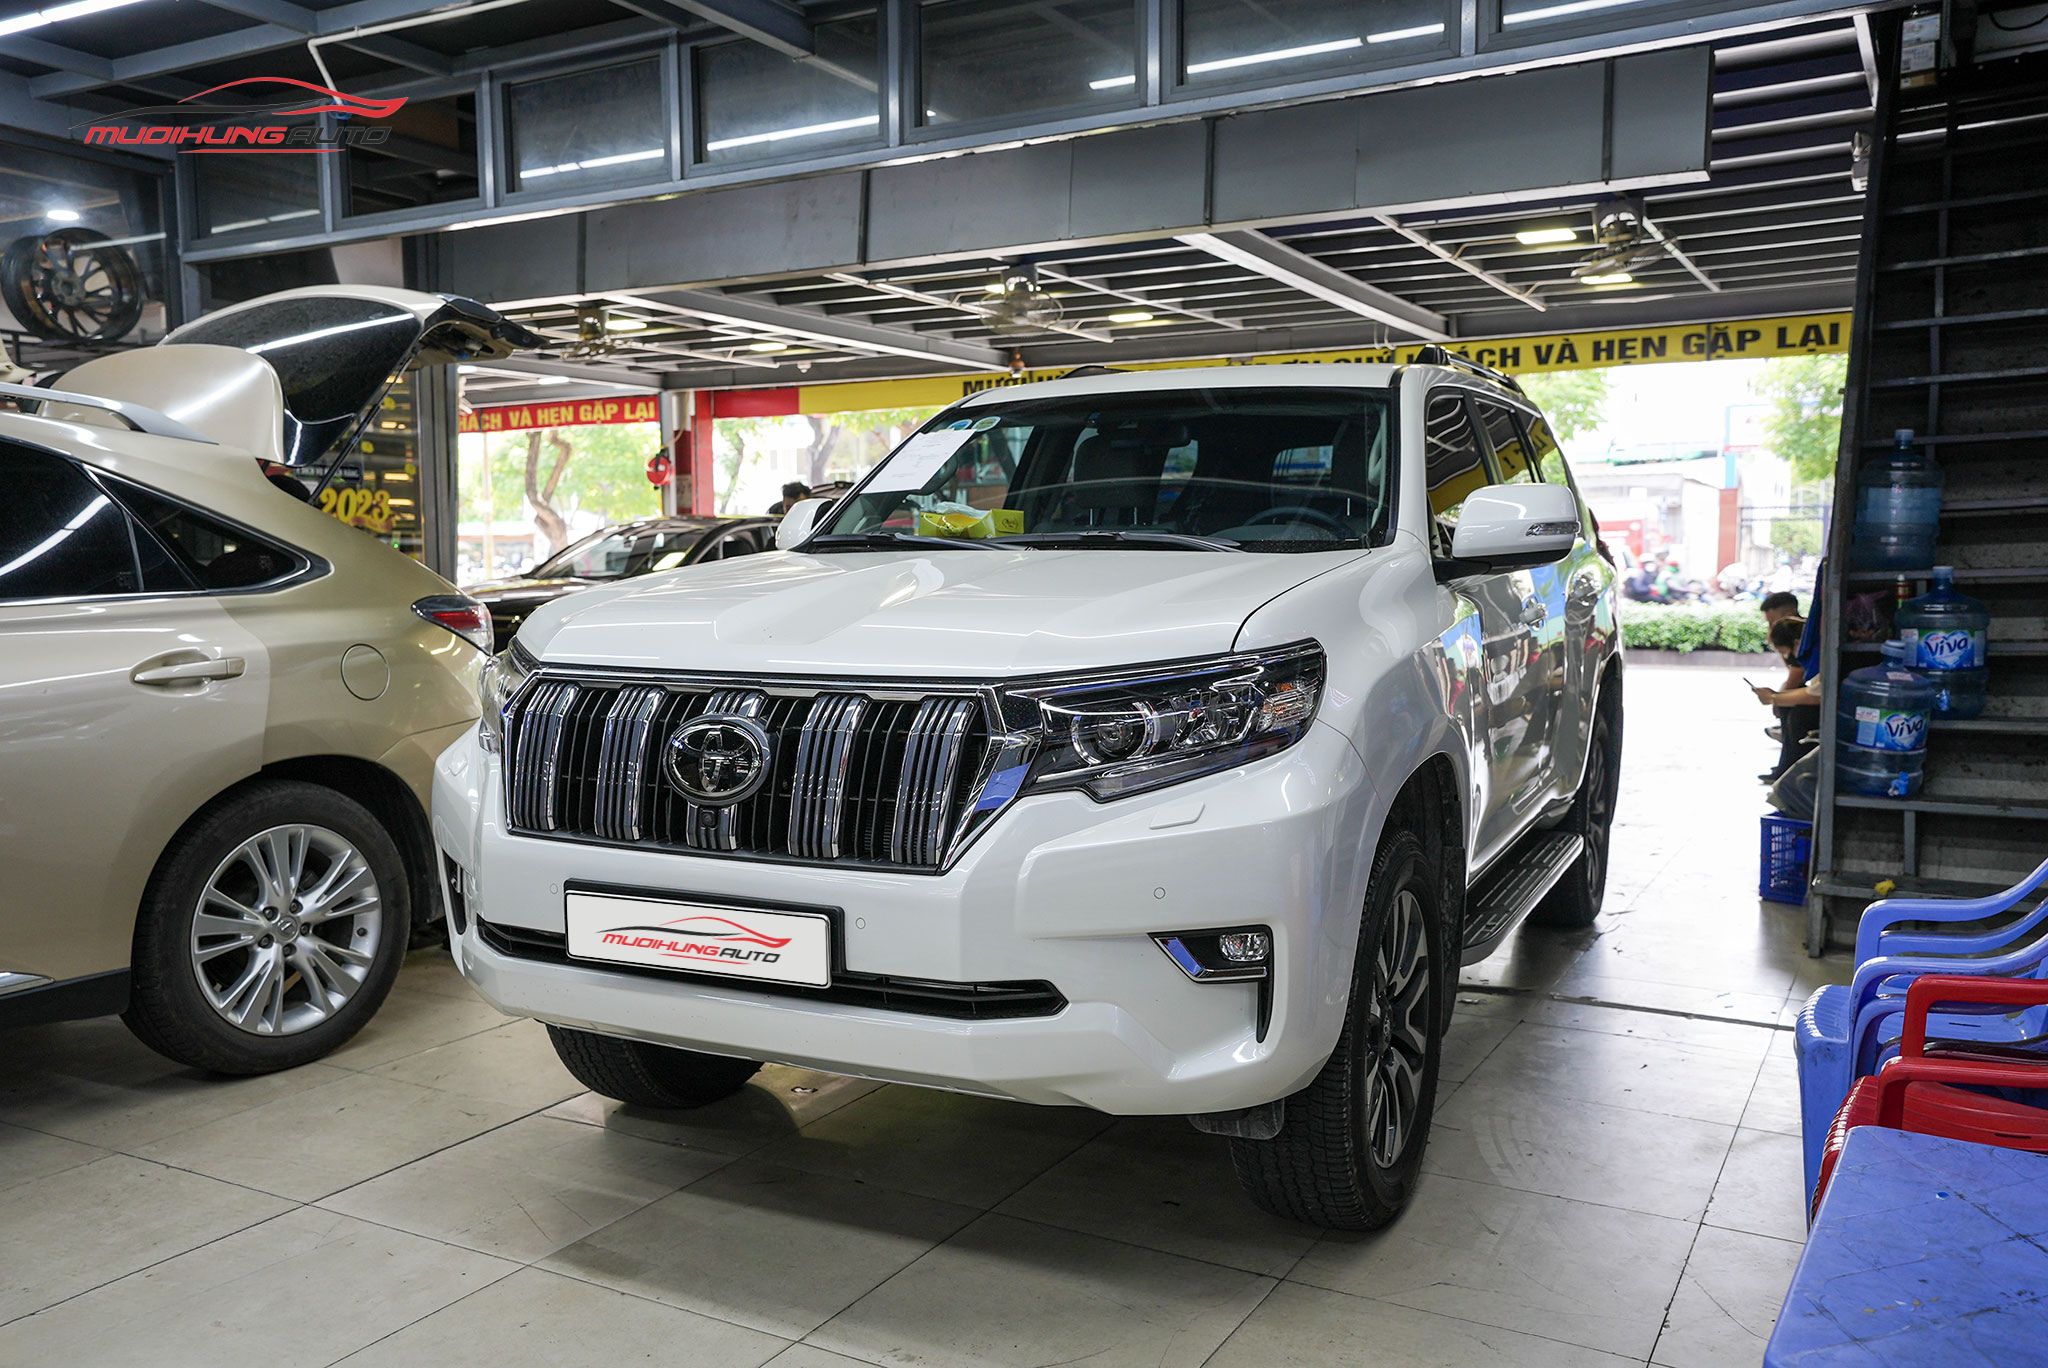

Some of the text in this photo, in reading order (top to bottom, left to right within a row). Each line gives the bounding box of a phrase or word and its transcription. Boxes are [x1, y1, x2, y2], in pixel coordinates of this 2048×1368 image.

[1533, 338, 1578, 366] VÀ
[1592, 335, 1667, 364] HẸN
[1681, 326, 1762, 358] GẶP
[1776, 322, 1839, 352] LẠI
[459, 400, 655, 431] HÁCH VÀ HẸN GẶP LẠI
[319, 487, 391, 523] 2023
